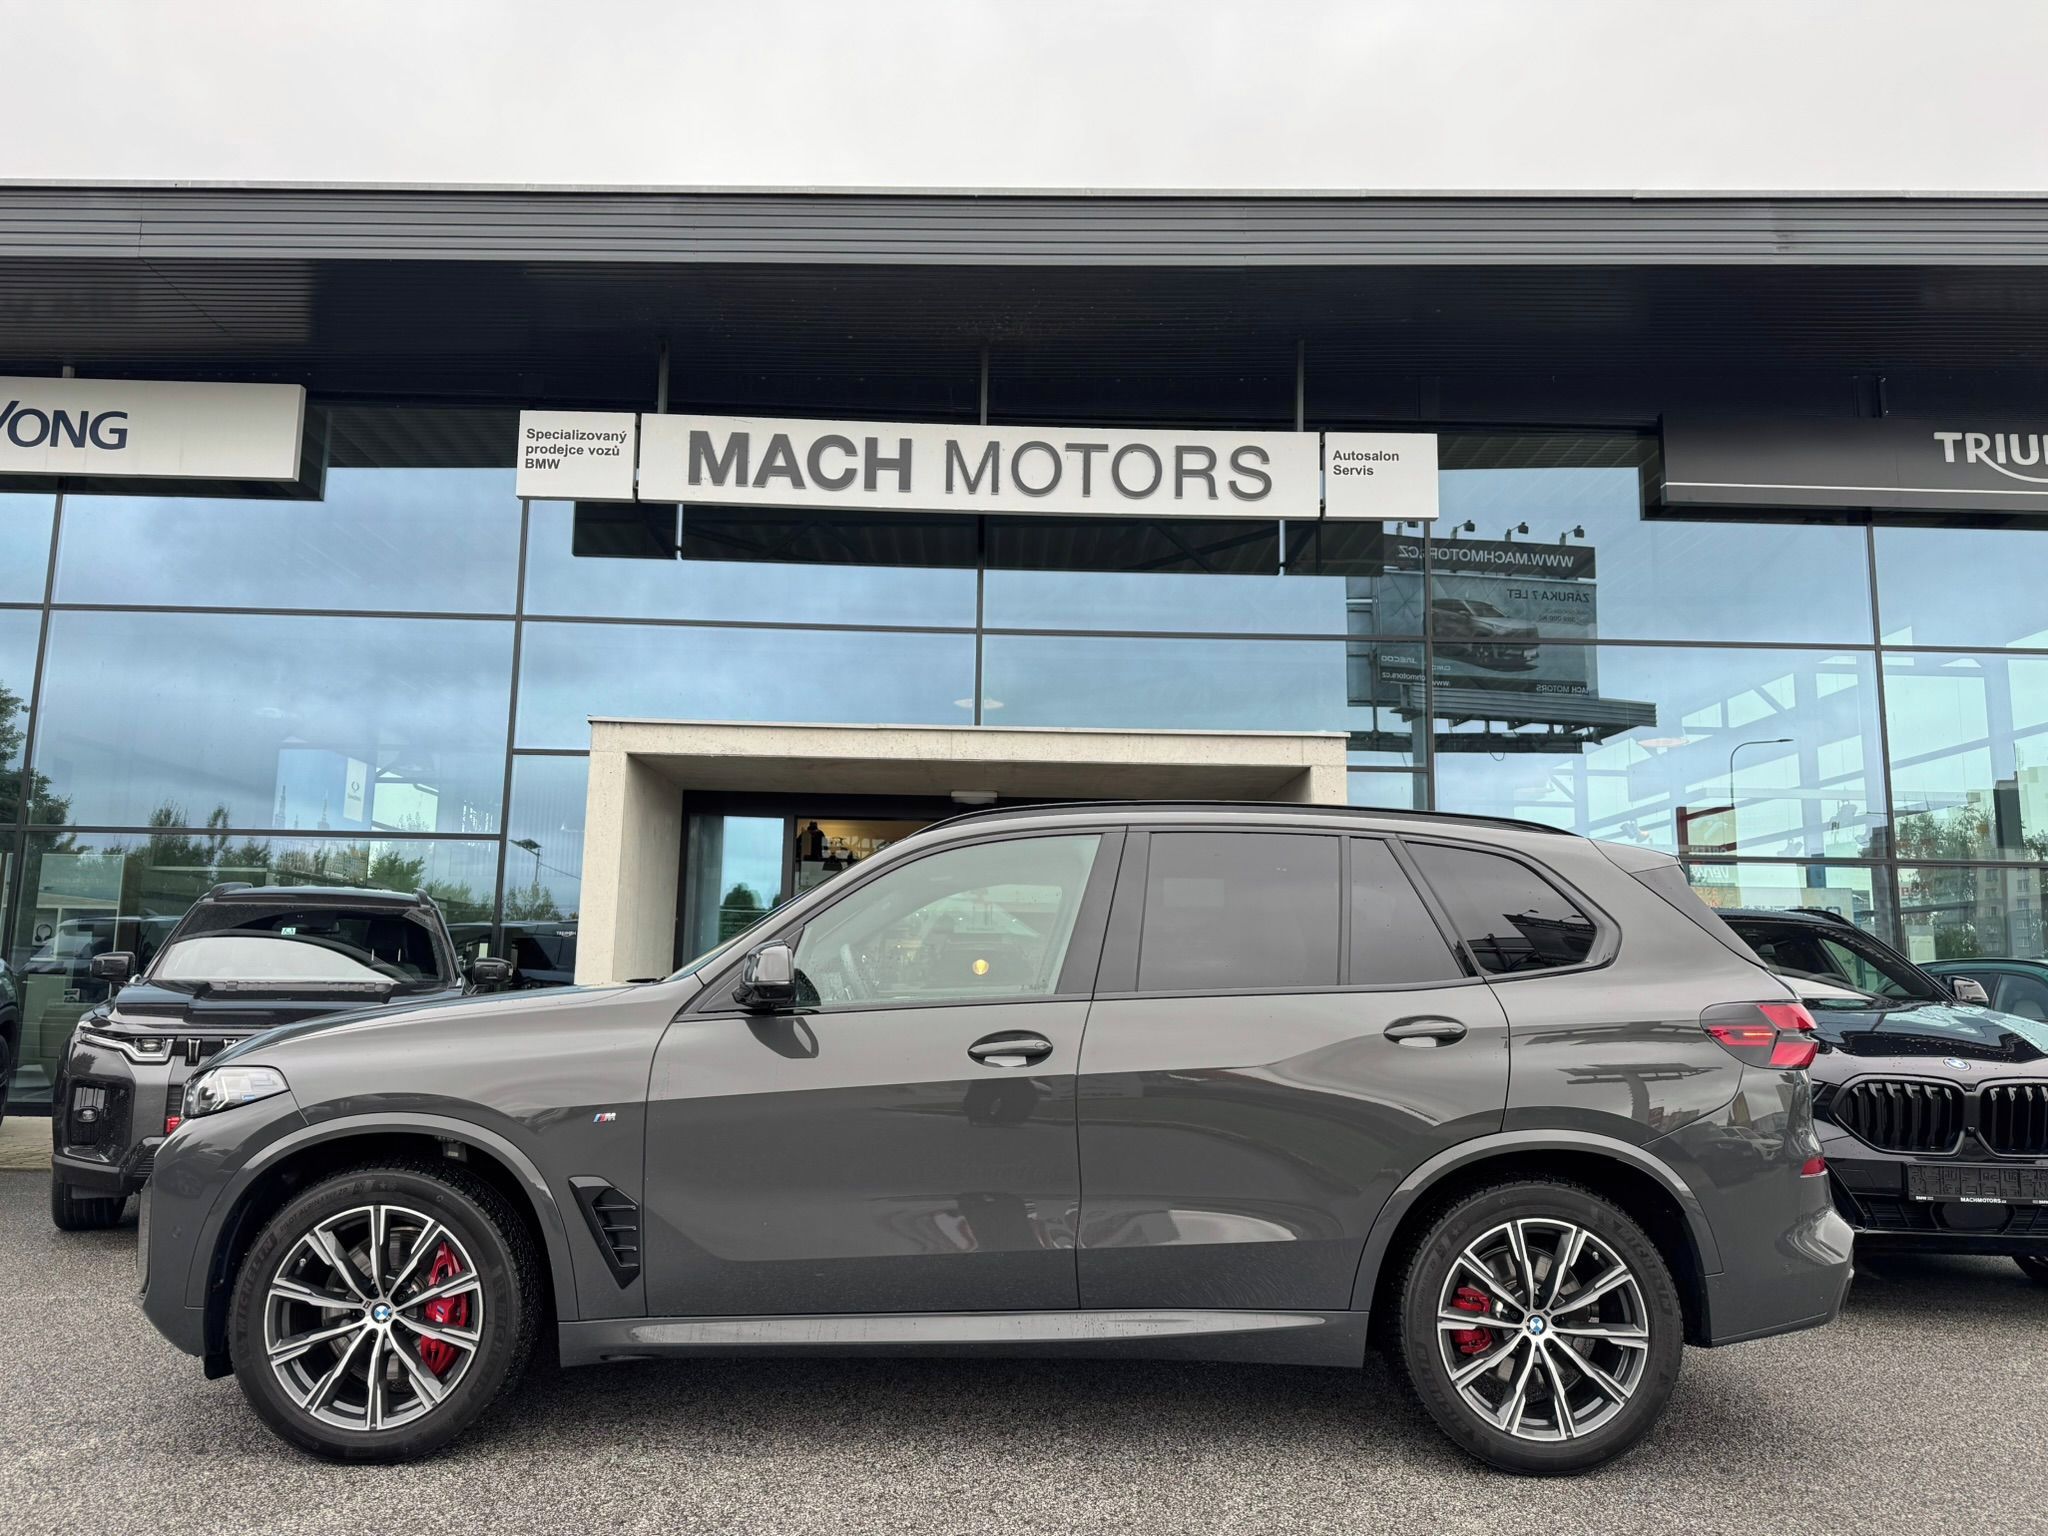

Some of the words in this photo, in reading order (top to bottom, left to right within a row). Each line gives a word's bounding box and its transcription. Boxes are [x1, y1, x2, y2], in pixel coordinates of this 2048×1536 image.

[526, 428, 627, 444] Specializovaný
[525, 444, 584, 457] prodejce
[588, 445, 620, 456] vozů
[1333, 450, 1400, 461] Autosalon
[1933, 431, 2048, 482] TRIU
[525, 458, 560, 469] BMW
[687, 430, 912, 492] MACH
[945, 439, 1273, 501] MOTORS
[1333, 464, 1374, 475] Servis
